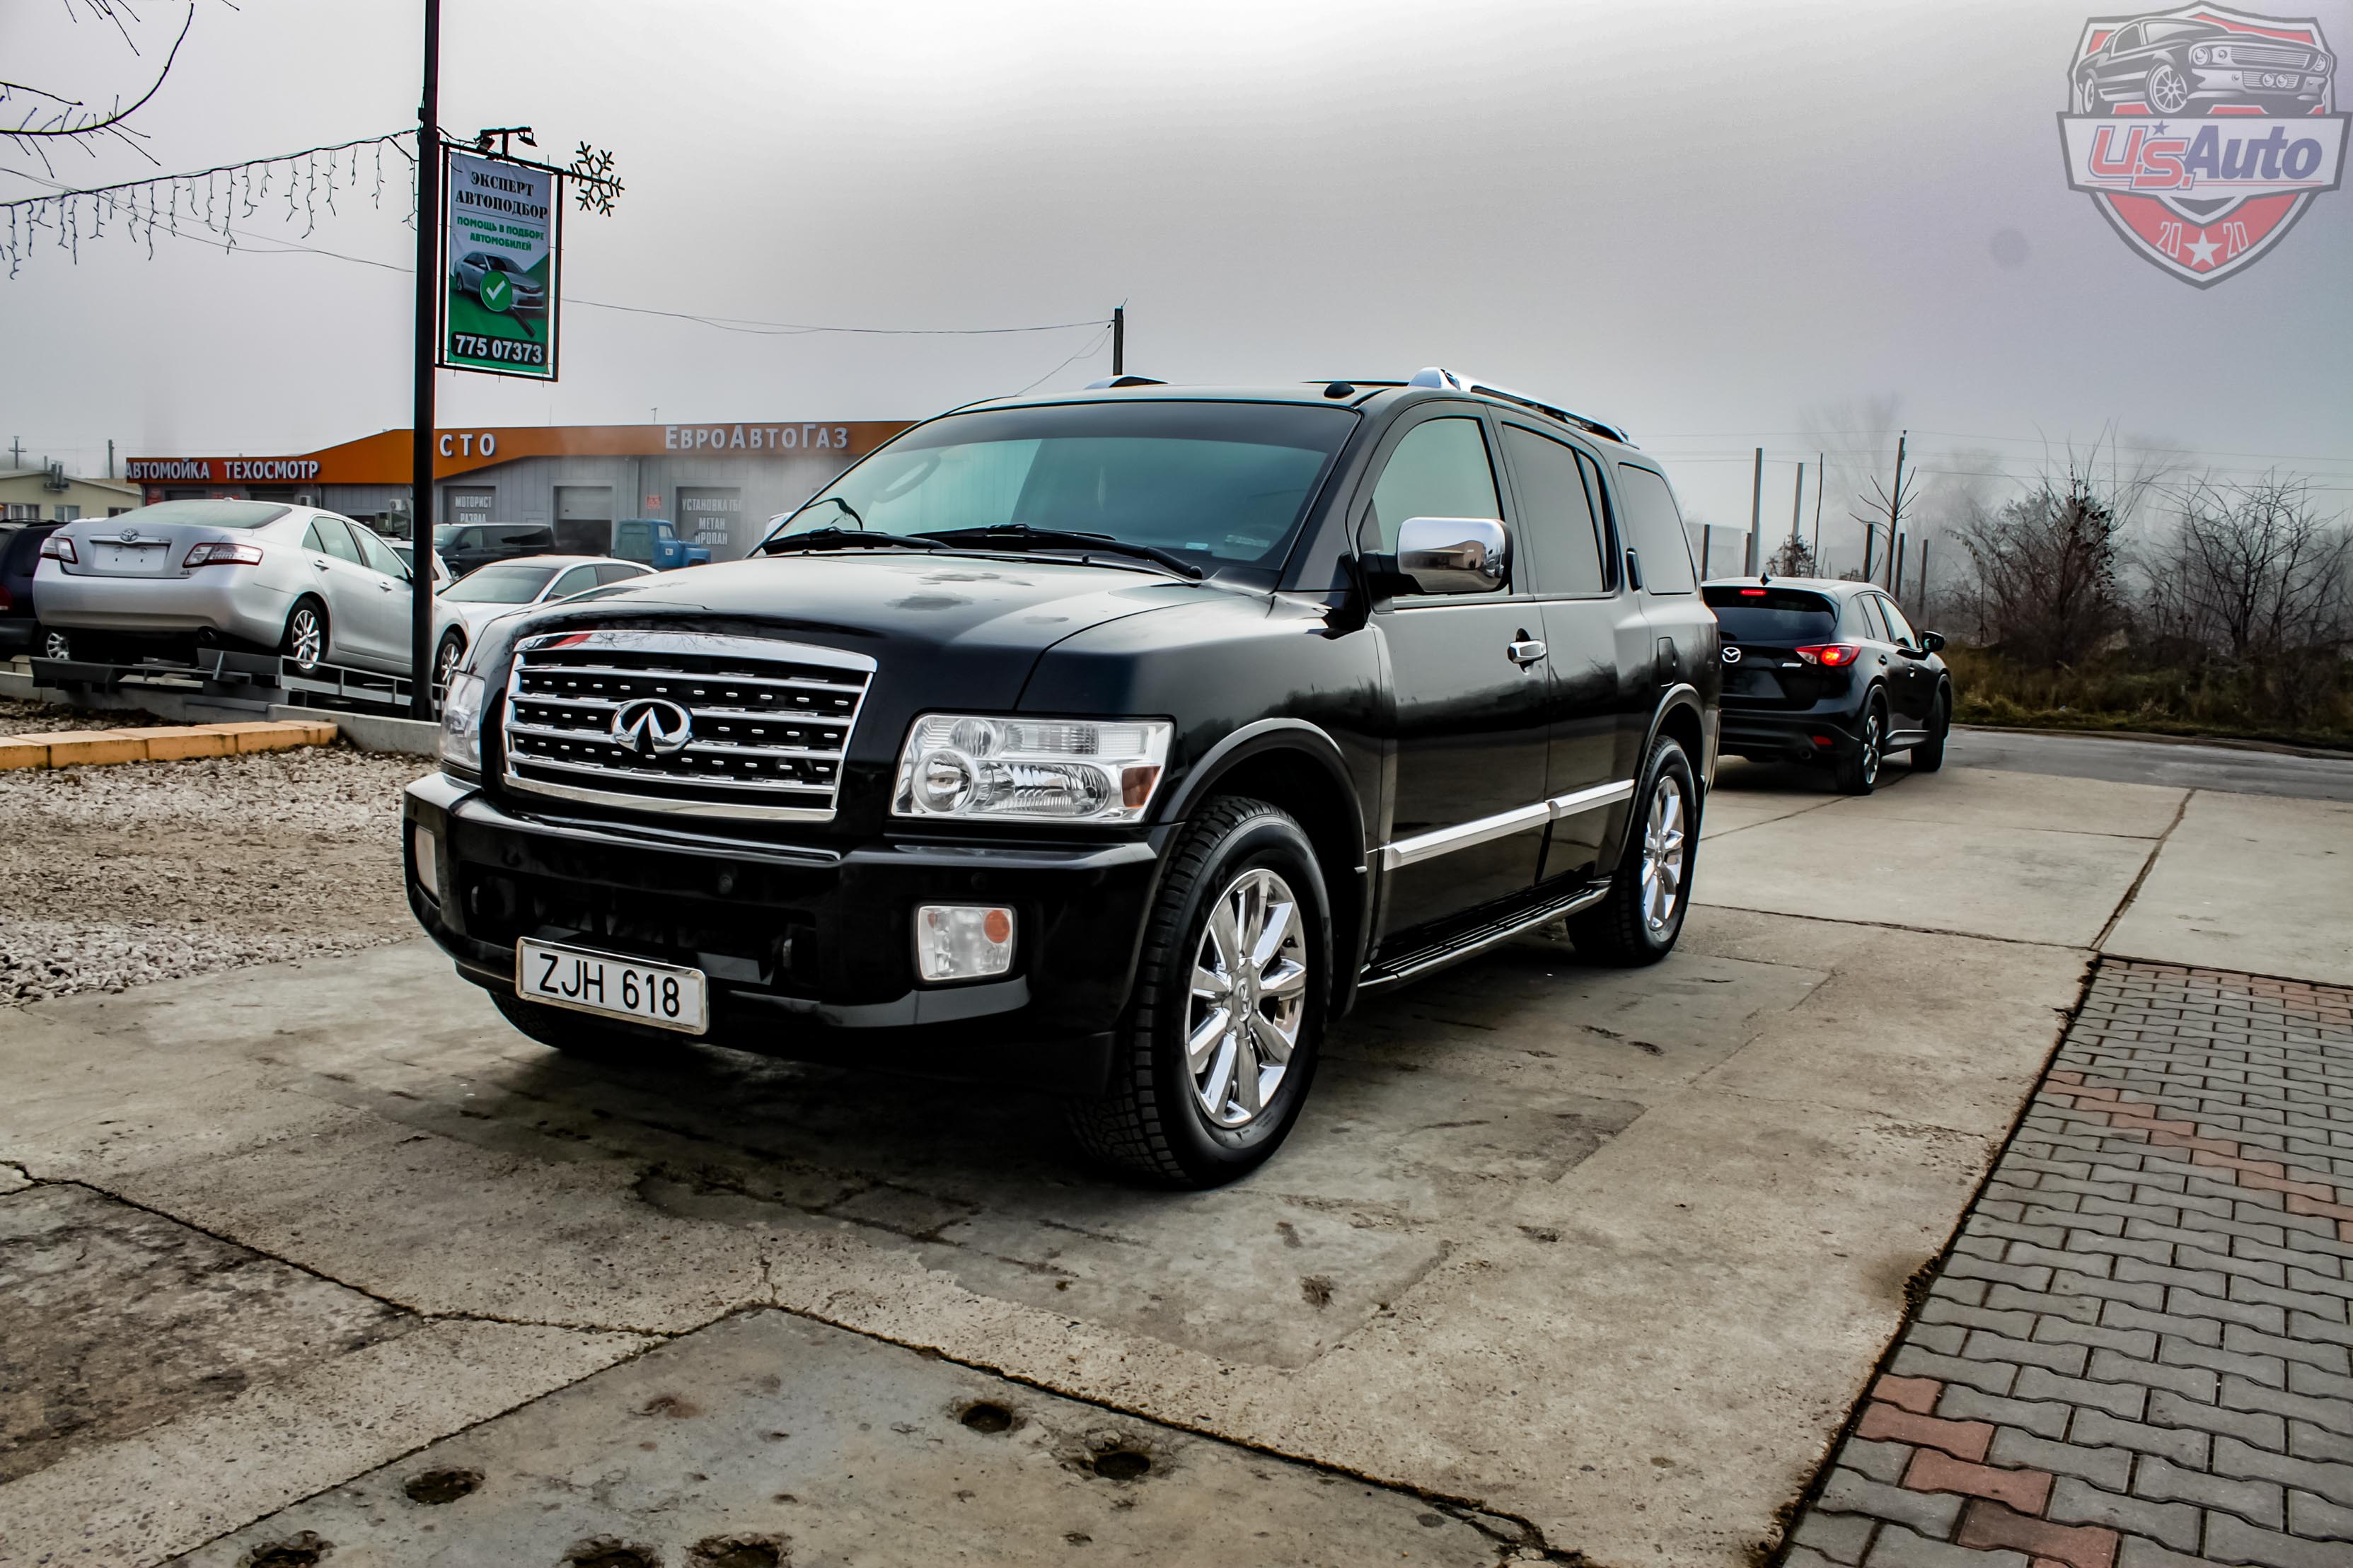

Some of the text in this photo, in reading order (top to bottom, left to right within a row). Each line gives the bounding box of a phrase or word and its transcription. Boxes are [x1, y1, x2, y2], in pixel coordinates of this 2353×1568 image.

[470, 171, 535, 197] ЭКСПЕРТ
[455, 190, 548, 220] АВТОПОДБОР
[456, 216, 545, 240] ПОМОЩЬ В ПОДБОРЕ
[470, 232, 532, 252] АВТОМОБИЛЕЙ
[455, 334, 543, 364] 775 07373
[439, 433, 495, 457] СТО
[126, 458, 320, 480] АВТОМОЙКА ТЕХОСМОТР
[455, 496, 492, 508] МОТОРИСТ
[681, 499, 727, 511] УСТАНОВКА
[698, 517, 725, 530] МЕТАН
[539, 953, 680, 1017] ZJH 618
